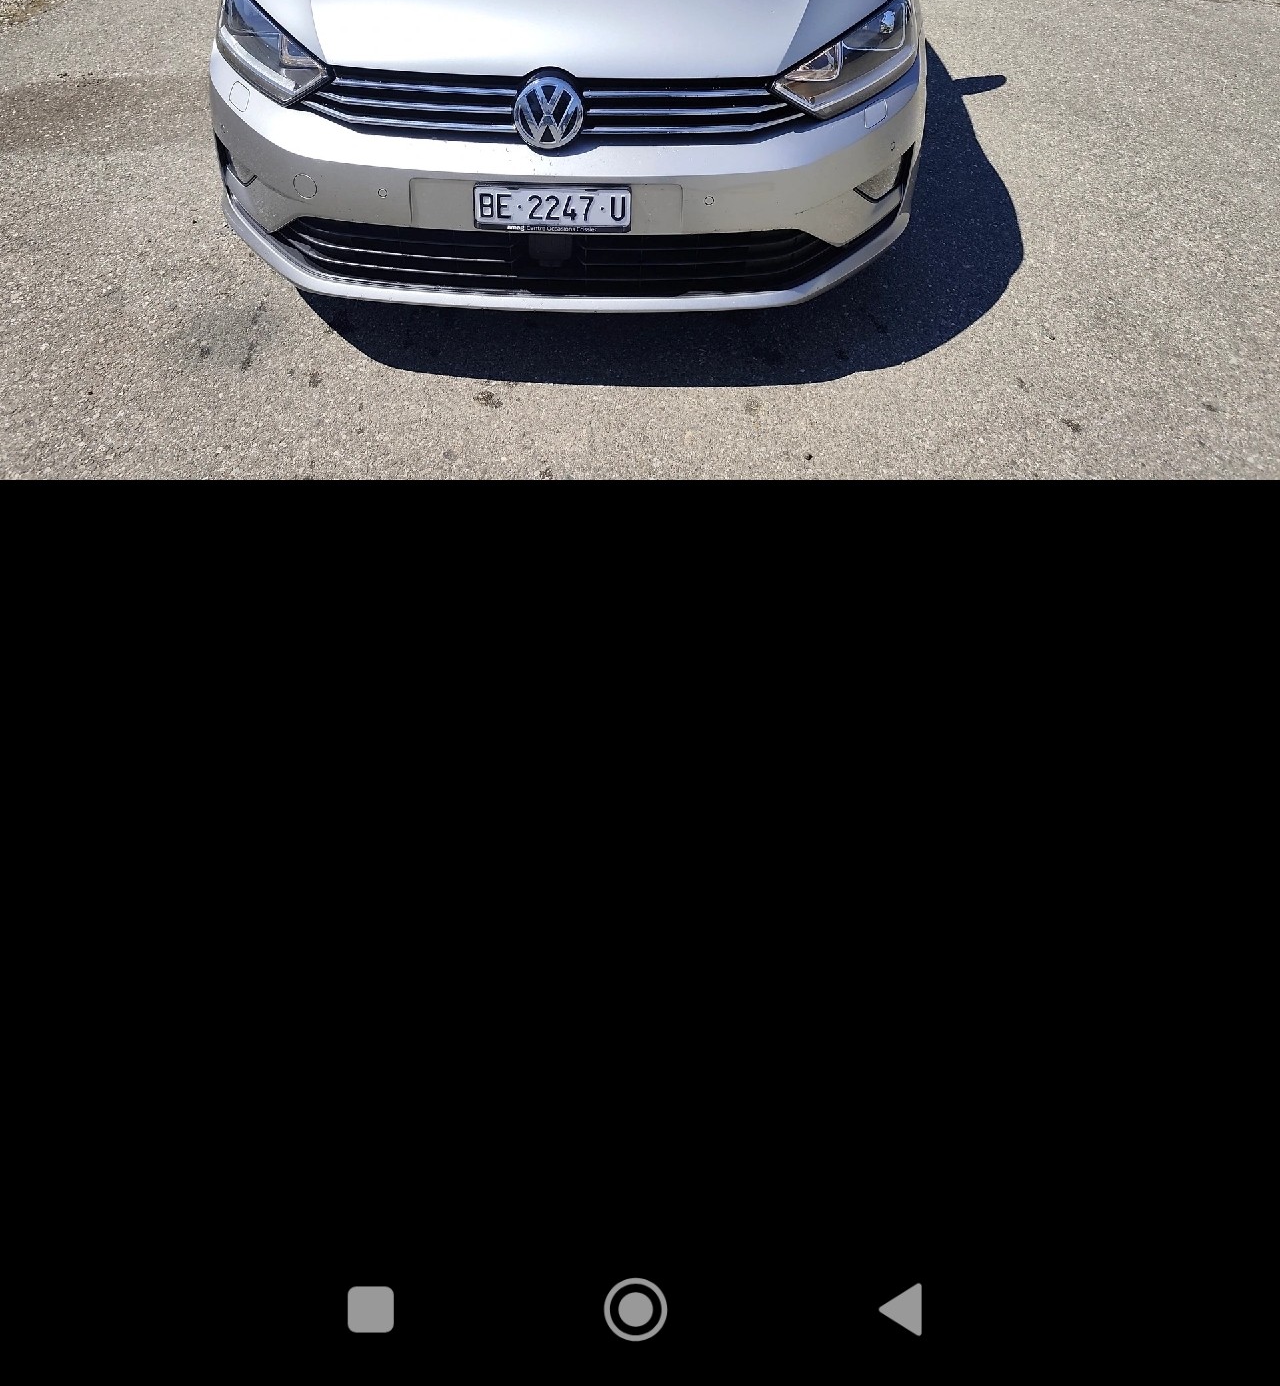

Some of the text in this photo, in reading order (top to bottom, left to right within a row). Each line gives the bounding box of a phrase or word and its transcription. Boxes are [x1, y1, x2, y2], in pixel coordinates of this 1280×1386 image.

[514, 77, 583, 149] VW
[479, 193, 626, 222] BE 2247 U
